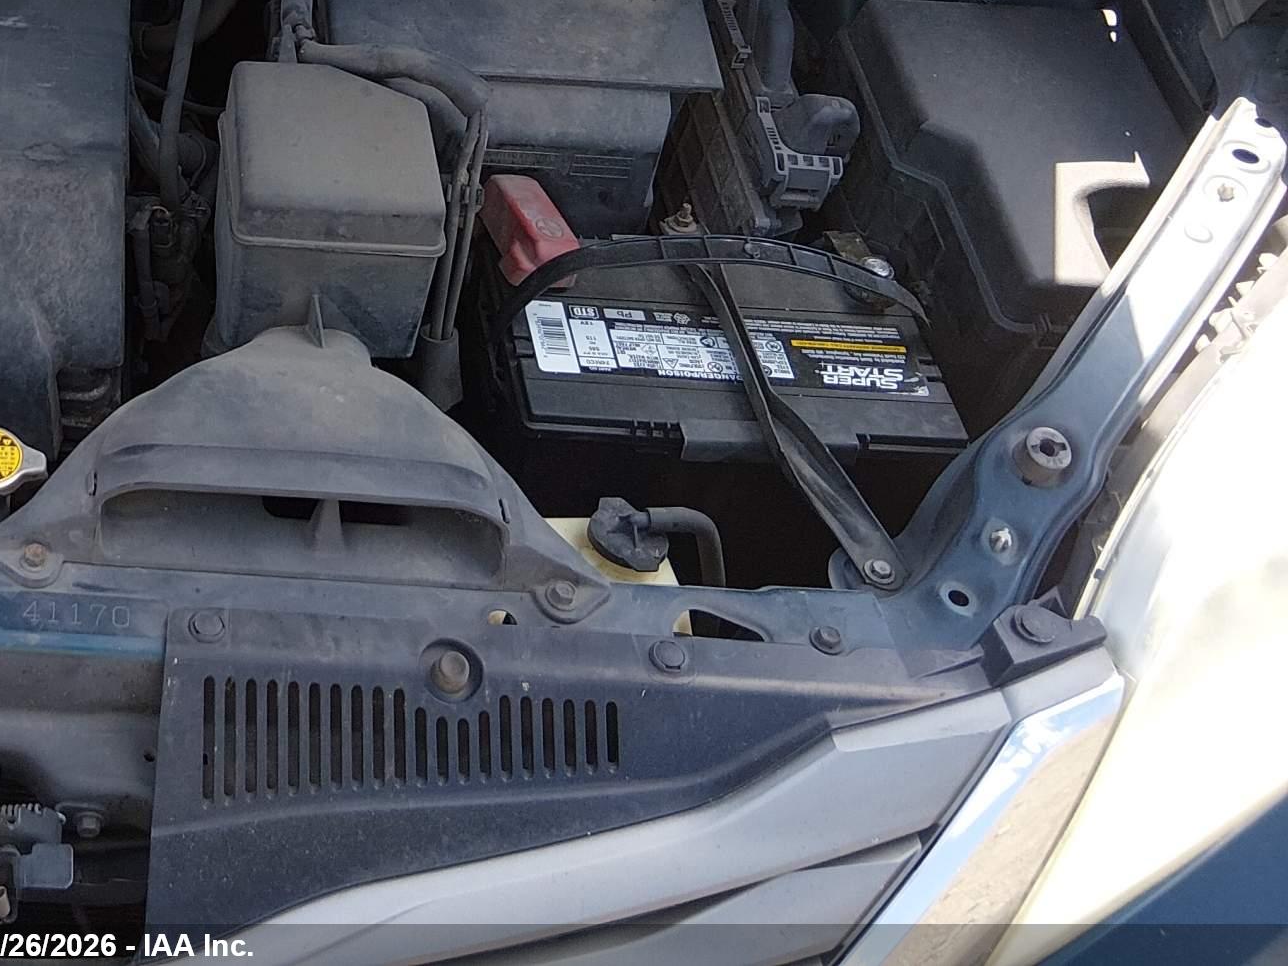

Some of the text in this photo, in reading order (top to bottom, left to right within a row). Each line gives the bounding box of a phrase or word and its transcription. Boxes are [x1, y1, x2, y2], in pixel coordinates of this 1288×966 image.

[573, 307, 595, 316] STD
[821, 365, 903, 381] START
[823, 375, 898, 390] SUPER
[21, 600, 131, 628] 41170
